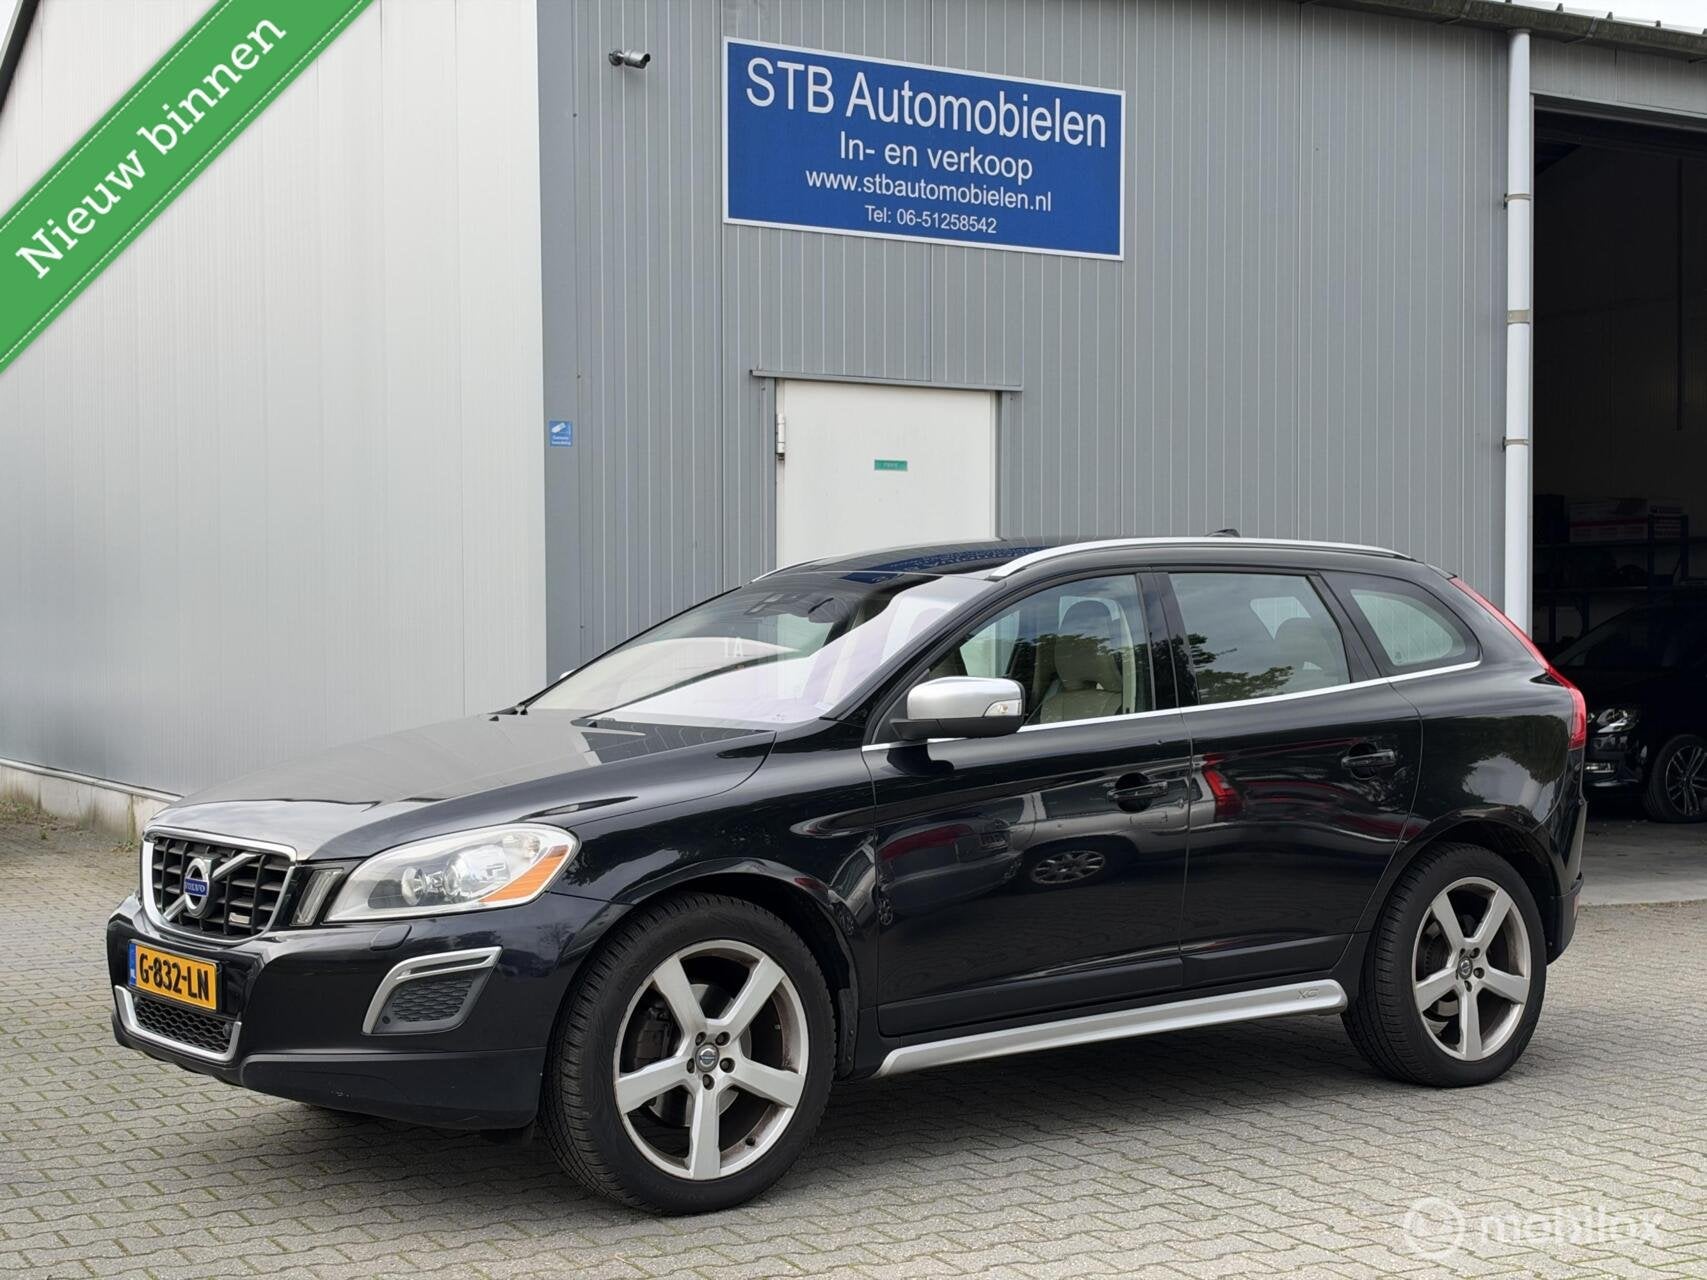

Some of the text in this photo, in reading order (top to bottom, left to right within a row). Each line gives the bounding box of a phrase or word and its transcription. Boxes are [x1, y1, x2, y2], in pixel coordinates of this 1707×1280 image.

[746, 57, 1106, 148] STB Automobielen
[840, 131, 1033, 185] In- en verkoop
[805, 169, 1052, 212] www.stbautomobielen.nl
[864, 205, 998, 234] Tel: 06-51258542
[184, 881, 206, 893] VOLVO
[139, 952, 210, 1002] G-832-LN
